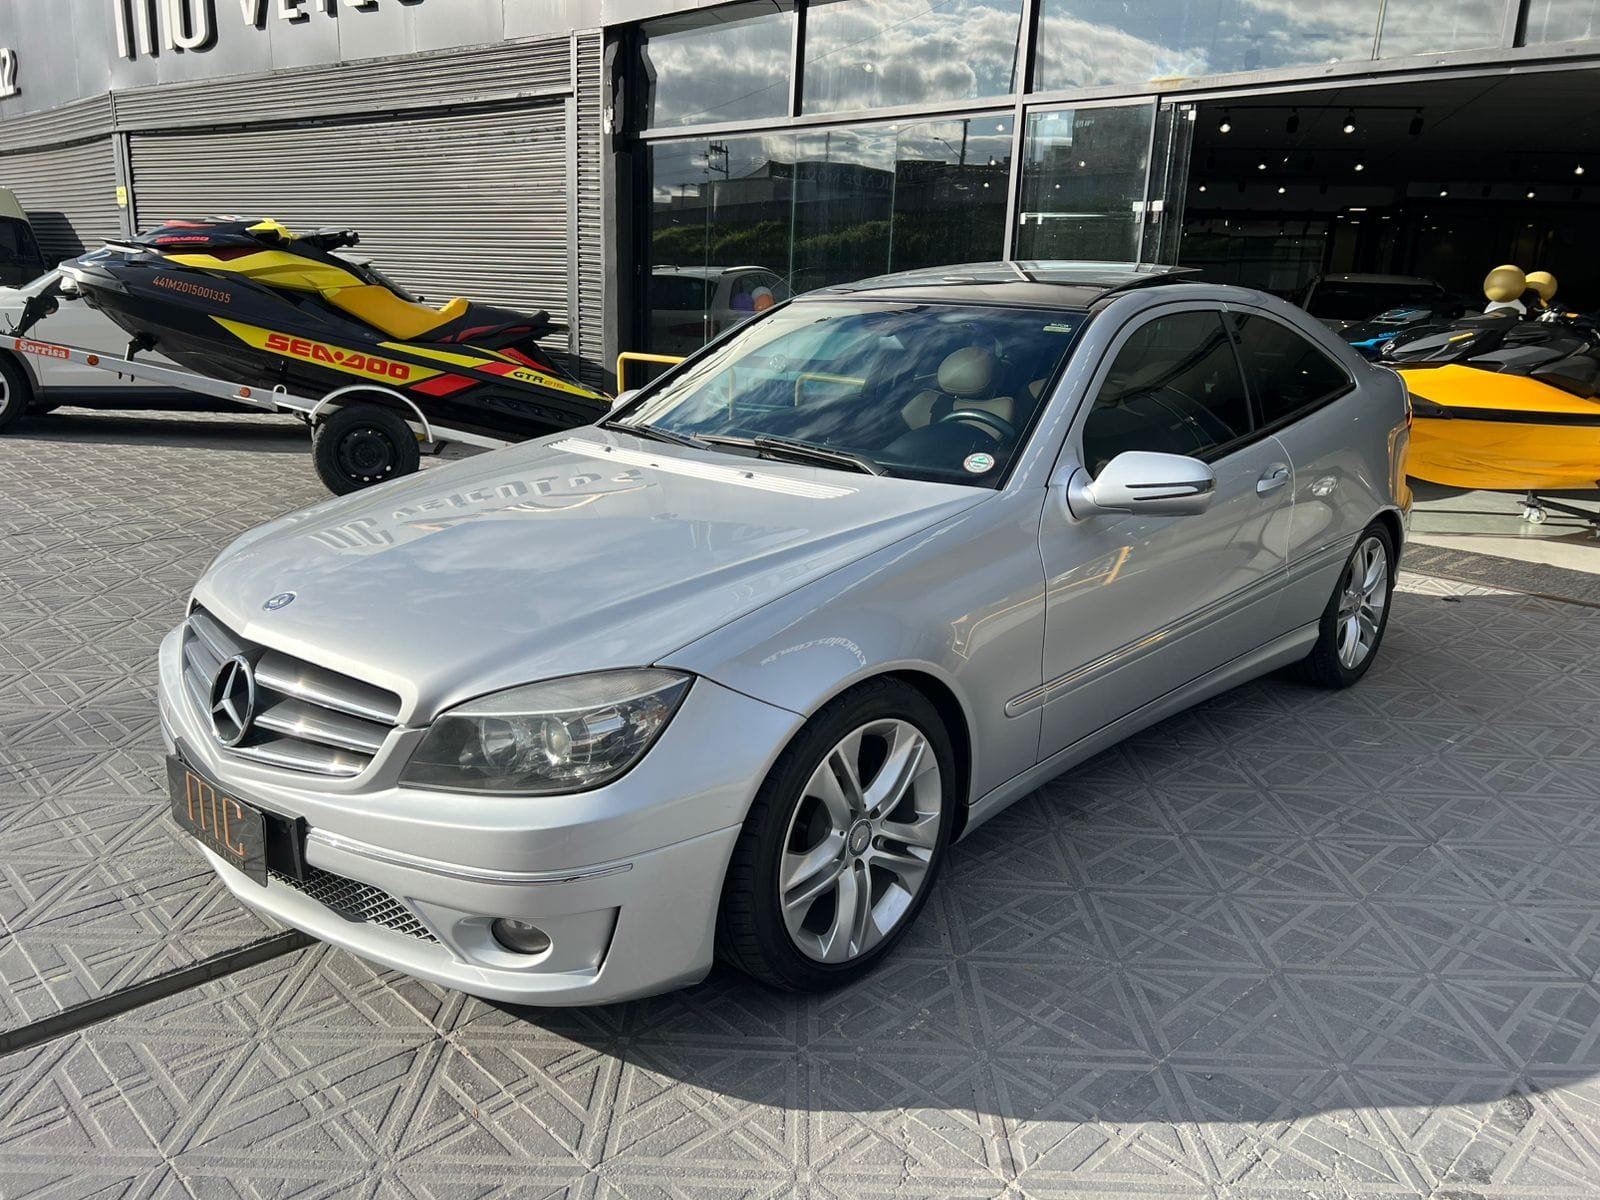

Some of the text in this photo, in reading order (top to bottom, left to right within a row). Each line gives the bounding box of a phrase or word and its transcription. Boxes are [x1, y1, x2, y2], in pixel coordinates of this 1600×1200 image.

[152, 275, 232, 304] 441M2015001335
[19, 341, 66, 359] Sorrisa
[513, 371, 544, 384] GTR
